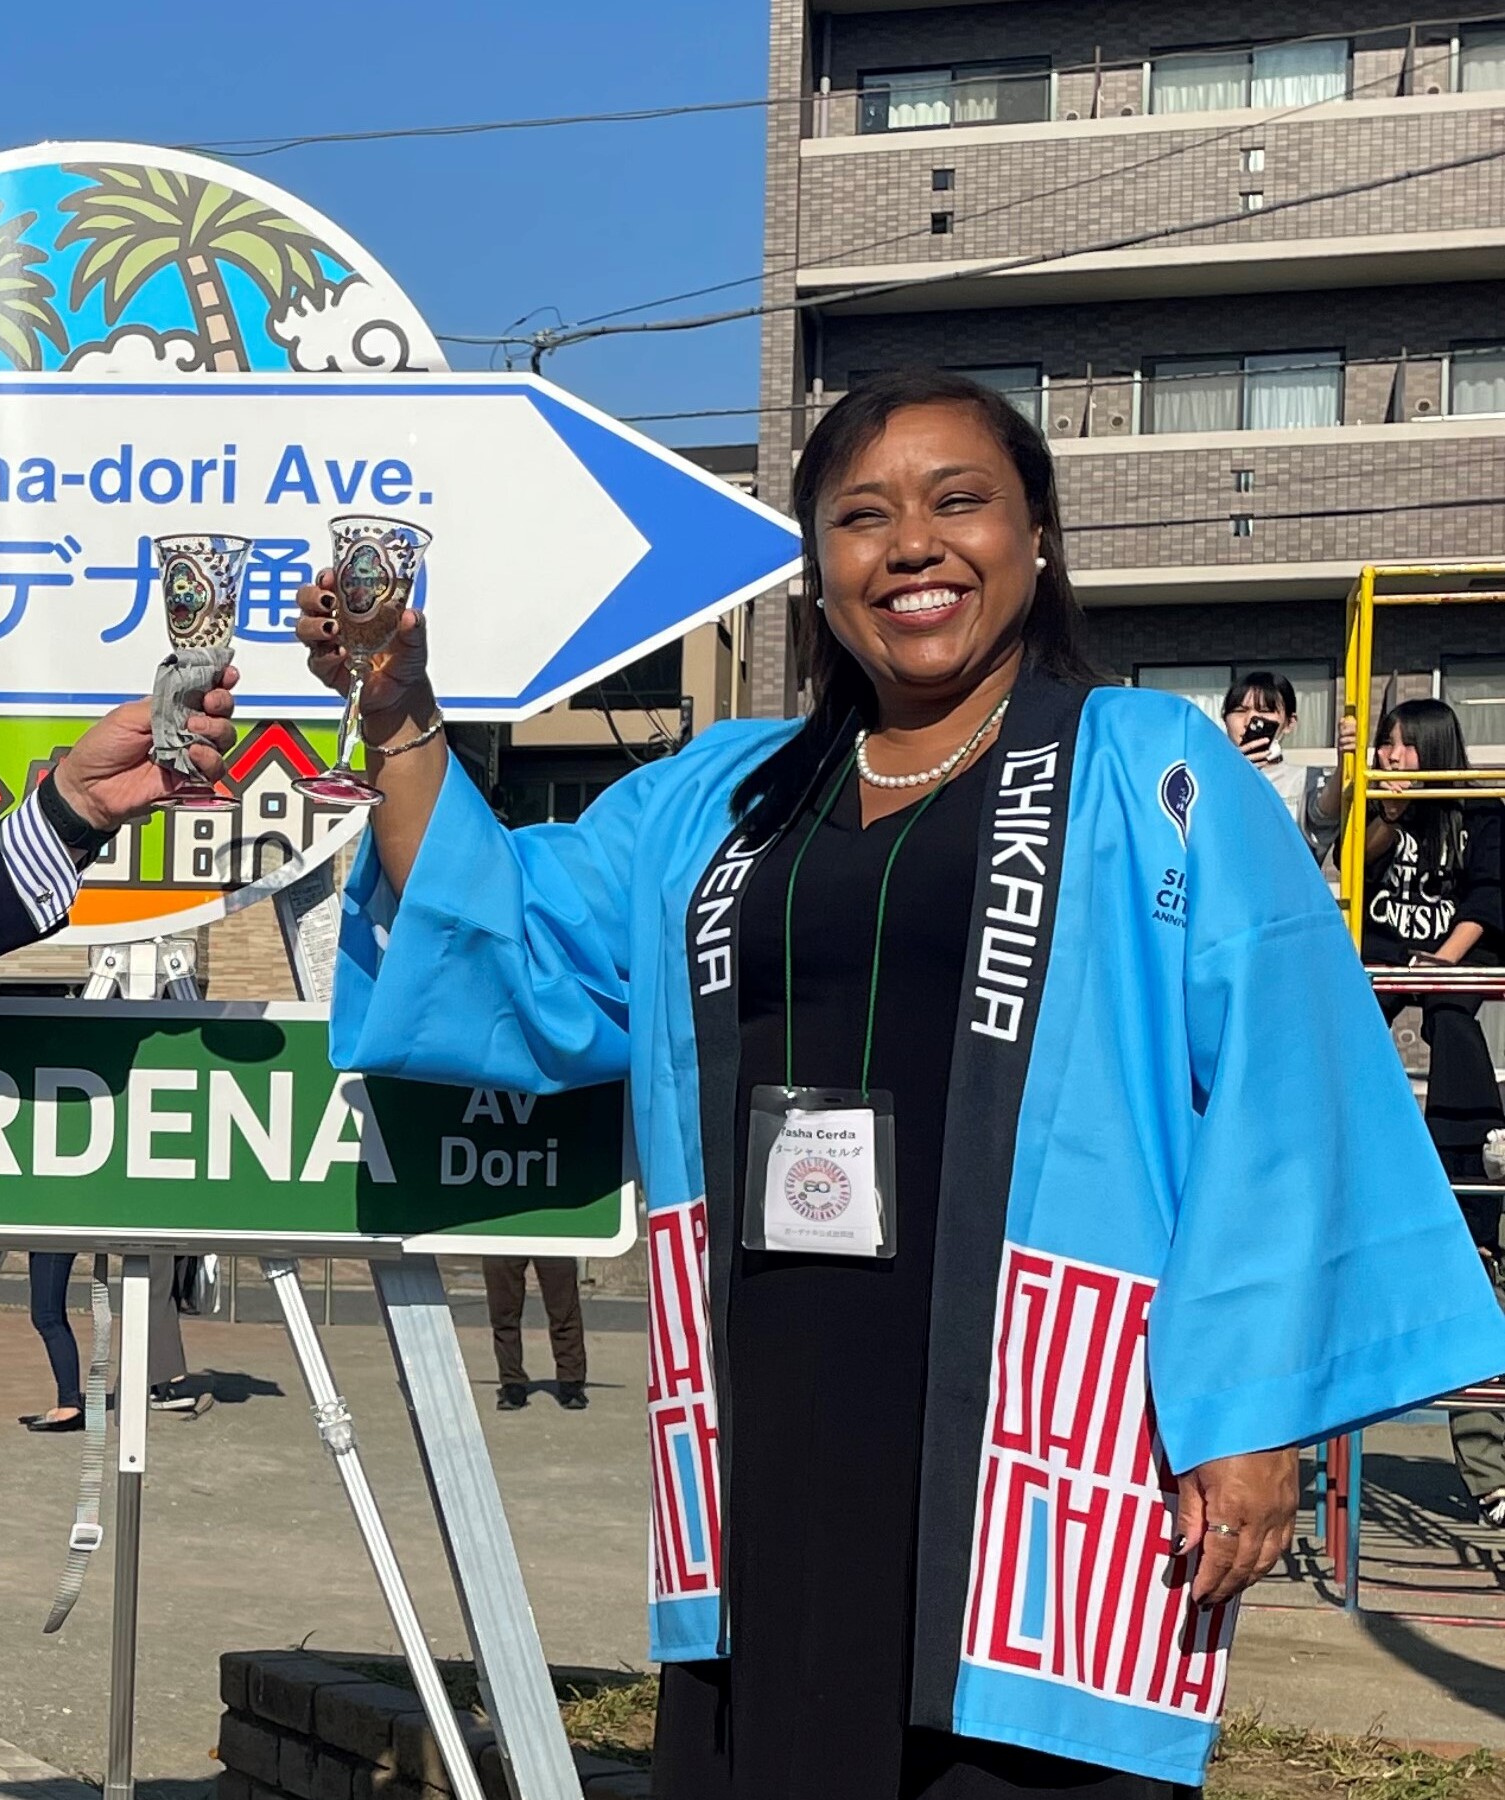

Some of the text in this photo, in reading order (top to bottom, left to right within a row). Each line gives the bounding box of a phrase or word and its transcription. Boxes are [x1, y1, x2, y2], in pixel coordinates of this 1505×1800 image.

[266, 443, 434, 506] Ave.
[970, 740, 1060, 1043] ICHIKAWA
[439, 1136, 559, 1188] Dori
[816, 1129, 857, 1140] Cerda
